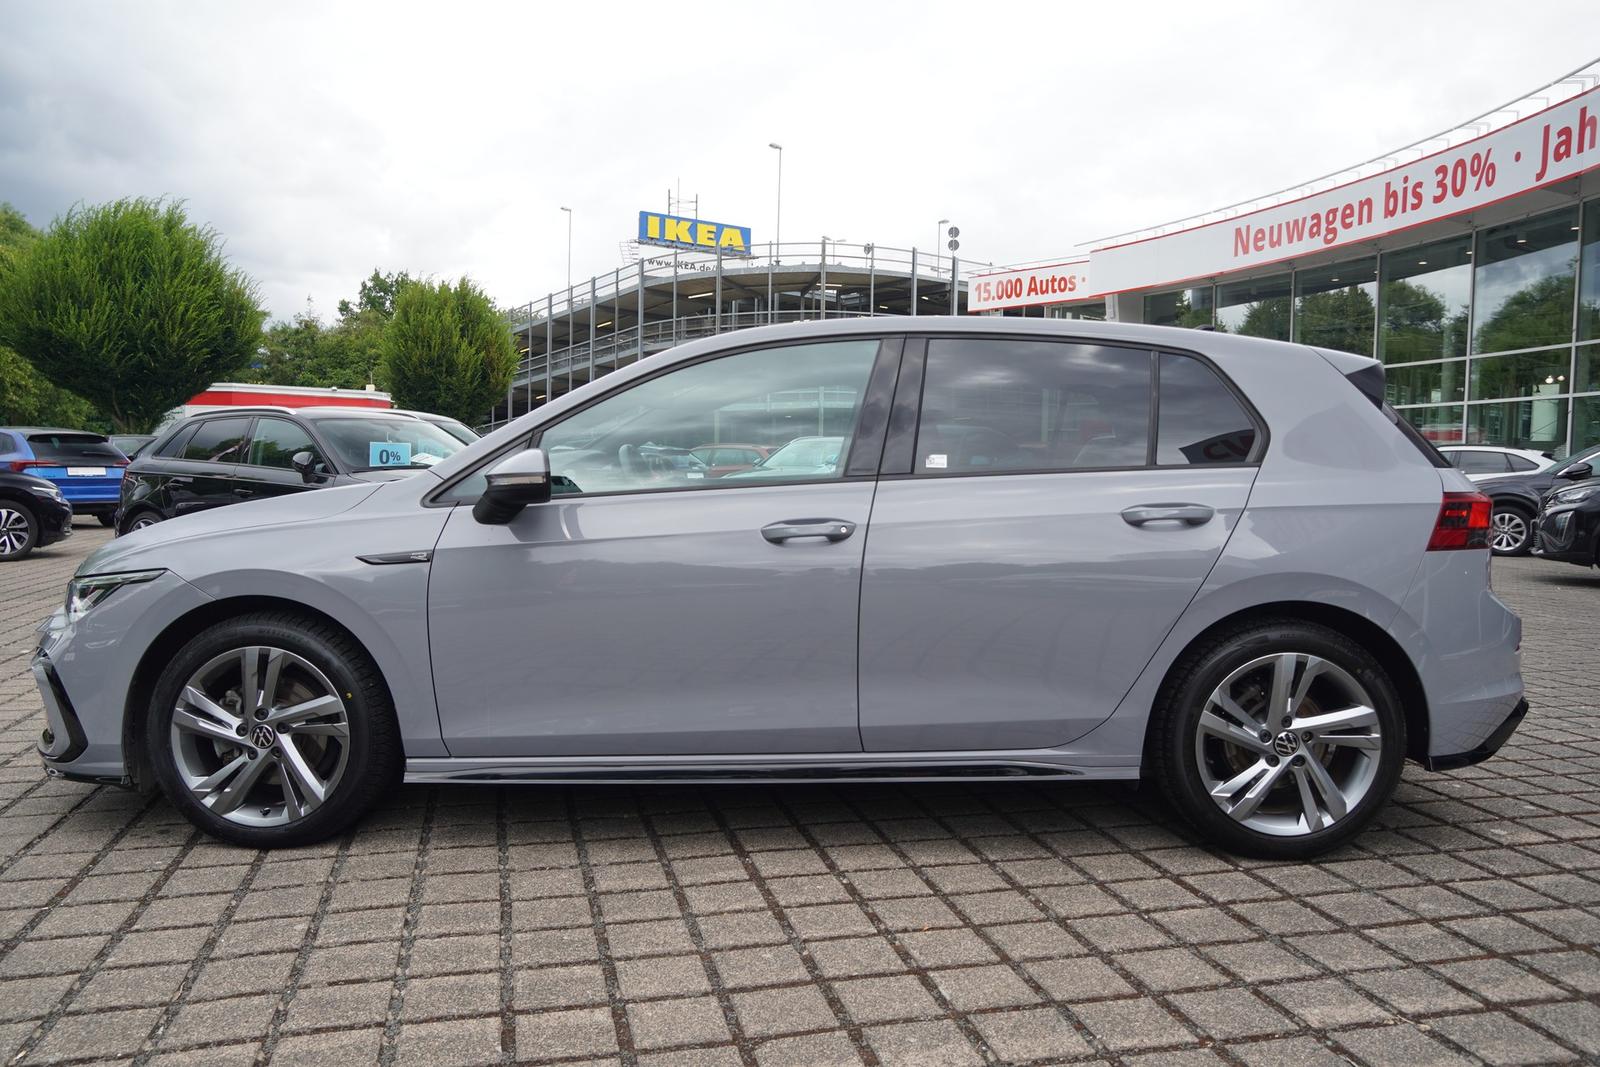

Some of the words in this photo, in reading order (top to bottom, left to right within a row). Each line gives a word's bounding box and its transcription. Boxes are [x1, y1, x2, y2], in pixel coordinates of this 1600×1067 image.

[1233, 197, 1373, 257] Neuwagen
[1383, 176, 1424, 219] bis
[1432, 148, 1496, 204] 30%
[647, 215, 746, 251] IKEA
[975, 277, 1023, 302] 15.000
[1026, 275, 1077, 297] Autos
[379, 449, 401, 464] 0%
